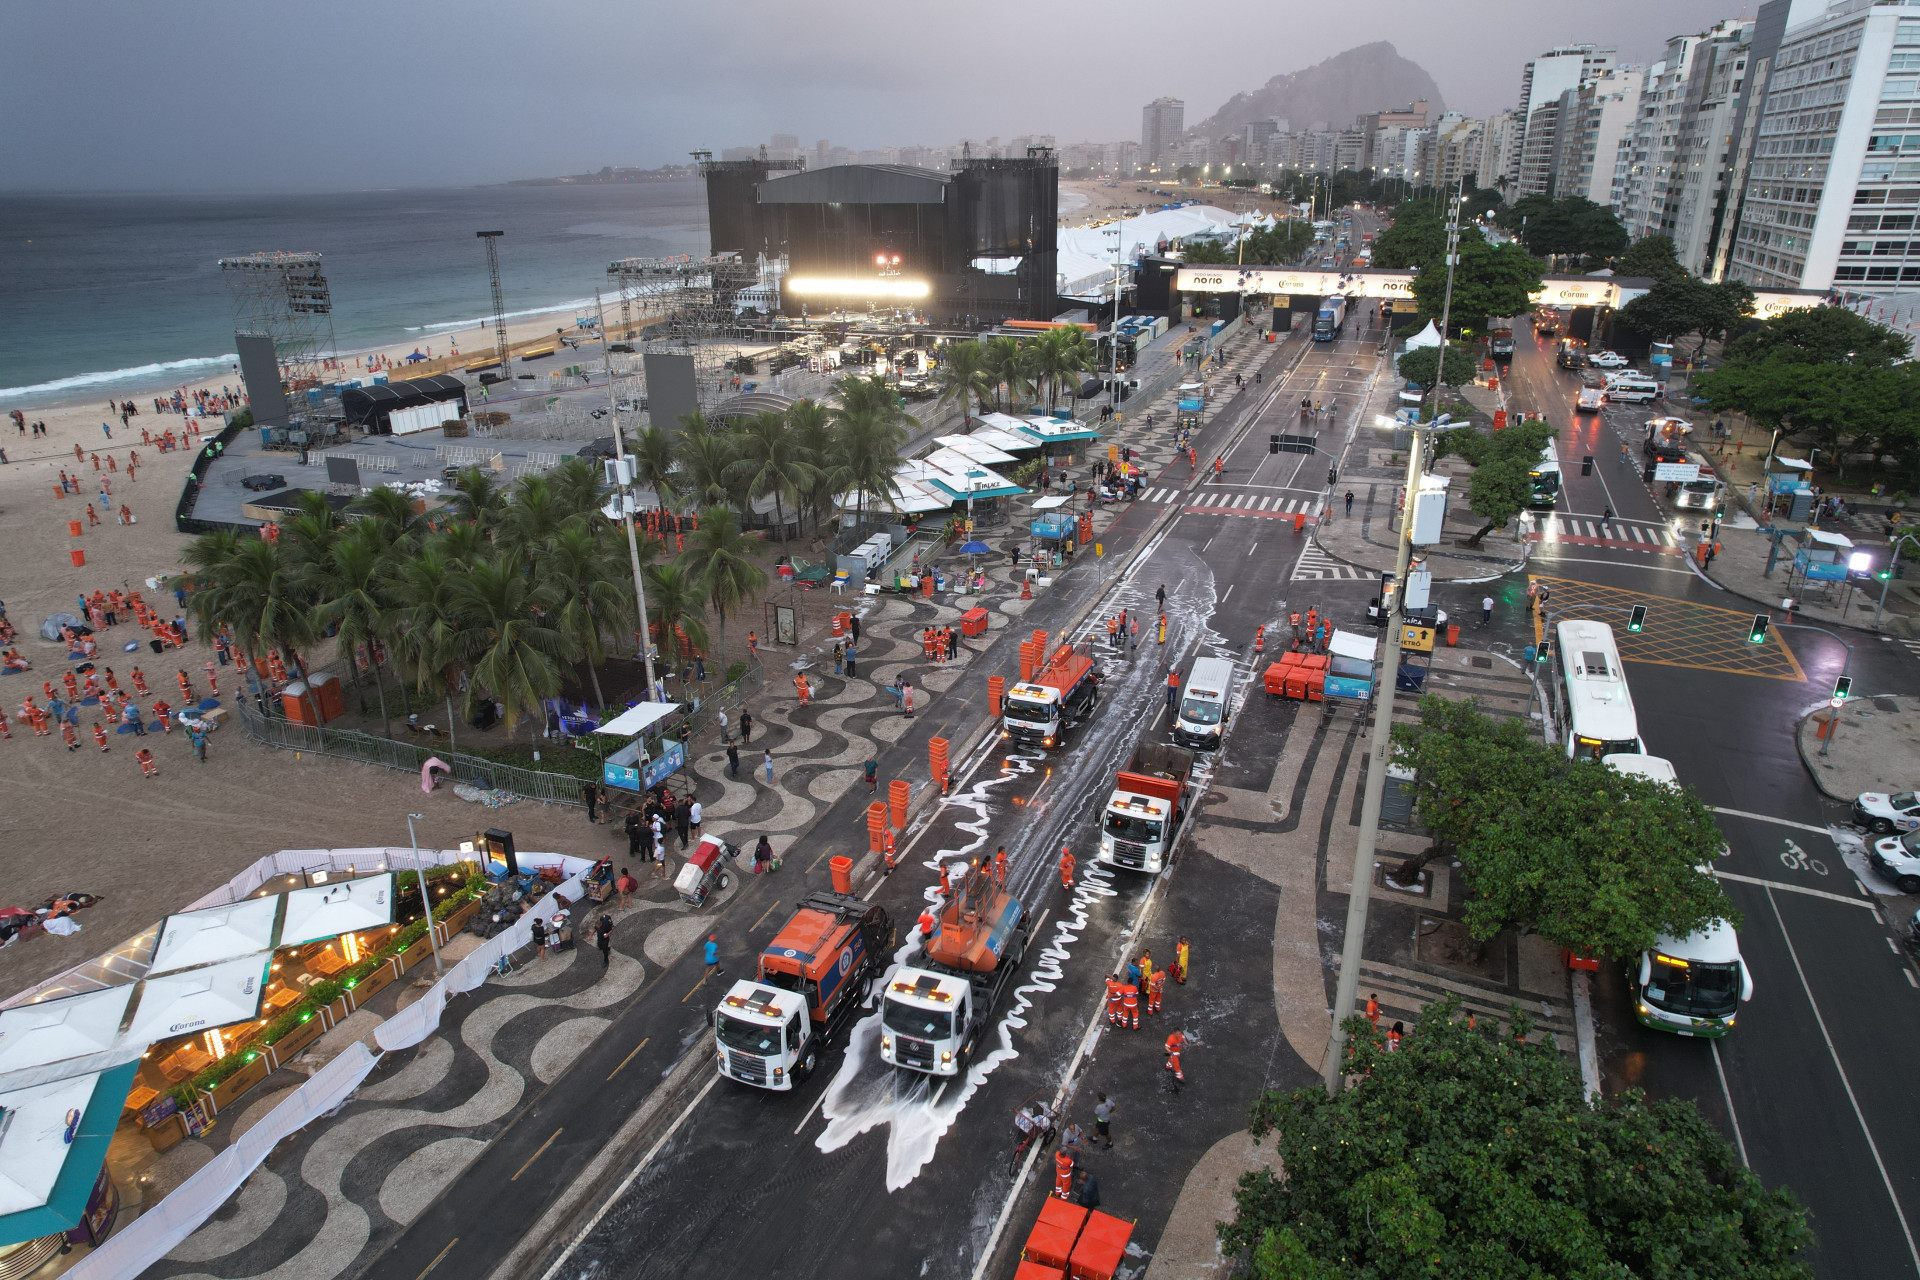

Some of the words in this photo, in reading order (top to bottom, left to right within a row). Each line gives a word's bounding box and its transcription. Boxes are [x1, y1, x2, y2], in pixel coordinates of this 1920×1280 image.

[1560, 290, 1589, 298] Corona
[244, 976, 254, 994] Corona
[169, 1019, 205, 1032] Corona
